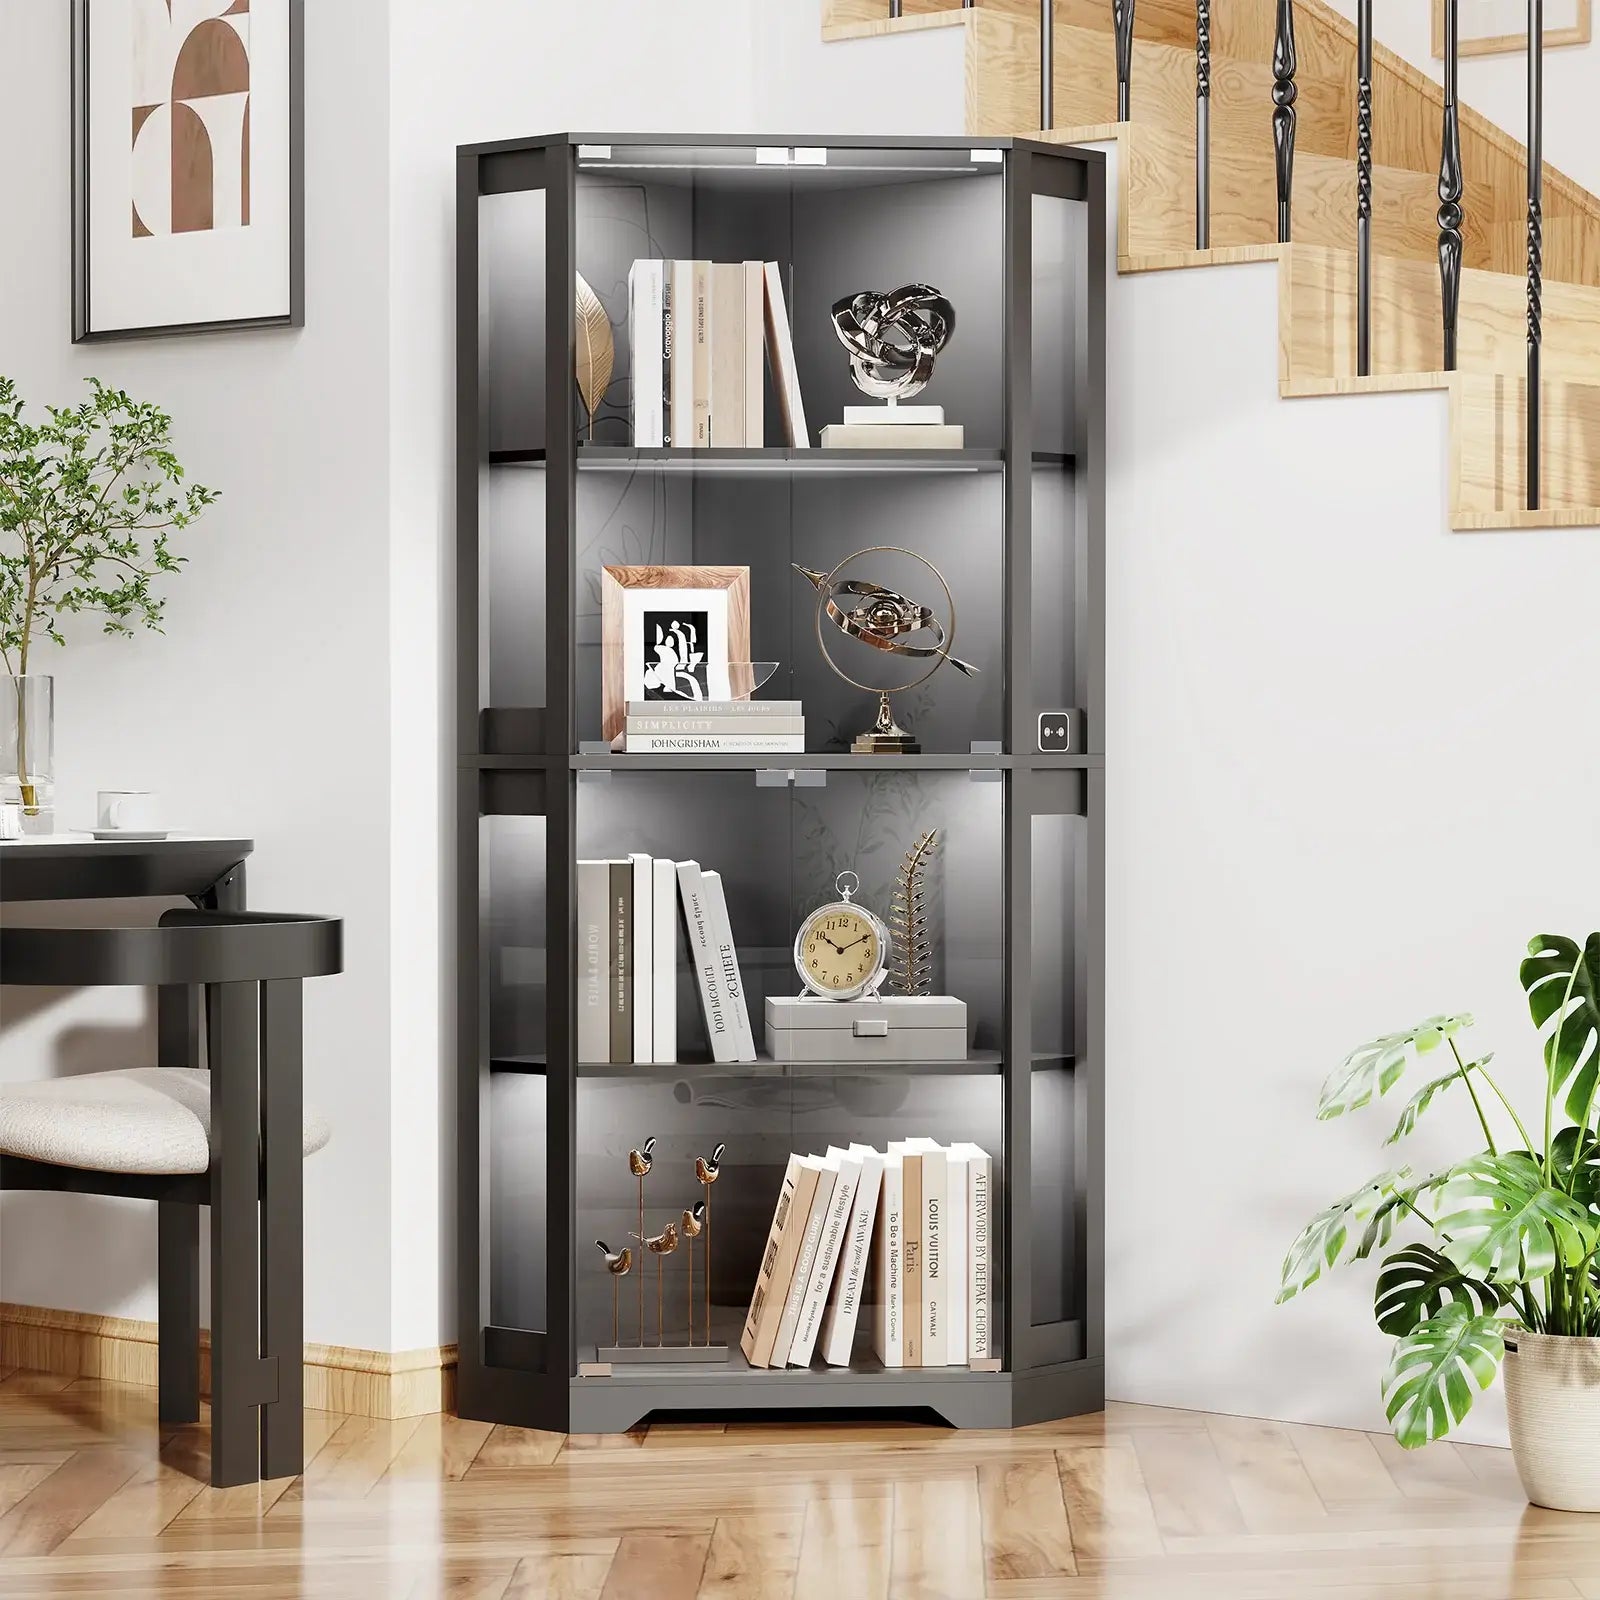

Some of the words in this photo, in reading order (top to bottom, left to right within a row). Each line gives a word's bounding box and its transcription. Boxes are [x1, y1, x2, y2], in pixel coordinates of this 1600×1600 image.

[662, 313, 673, 359] Caravaggio
[636, 720, 713, 730] SIMPLICITY
[826, 921, 836, 930] 11
[838, 918, 849, 927] 12
[816, 931, 826, 940] 10
[809, 944, 816, 952] 9
[864, 949, 870, 958] 3
[812, 959, 818, 968] 8
[858, 964, 864, 972] 4
[822, 971, 827, 980] 7
[832, 975, 839, 984] 6
[846, 973, 852, 982] 5
[976, 1172, 986, 1242] AFTERWORD
[890, 1212, 898, 1223] To
[929, 1198, 938, 1230] LOUIS
[855, 1209, 870, 1246] AWAKE
[890, 1225, 898, 1238] Be
[800, 1244, 814, 1273] GOOD
[808, 1212, 822, 1244] GUIDE
[814, 1280, 824, 1293] for
[820, 1220, 840, 1271] sustainable
[833, 1184, 850, 1219] lifestyle
[853, 1244, 863, 1266] world
[906, 1240, 918, 1274] Paris
[929, 1234, 938, 1278] VUITTON
[976, 1246, 986, 1260] BY
[850, 1266, 858, 1277] the
[890, 1249, 899, 1289] Machine
[976, 1263, 986, 1306] DEEPAK
[843, 1277, 858, 1314] DREAM
[976, 1308, 986, 1353] CHOPRA
